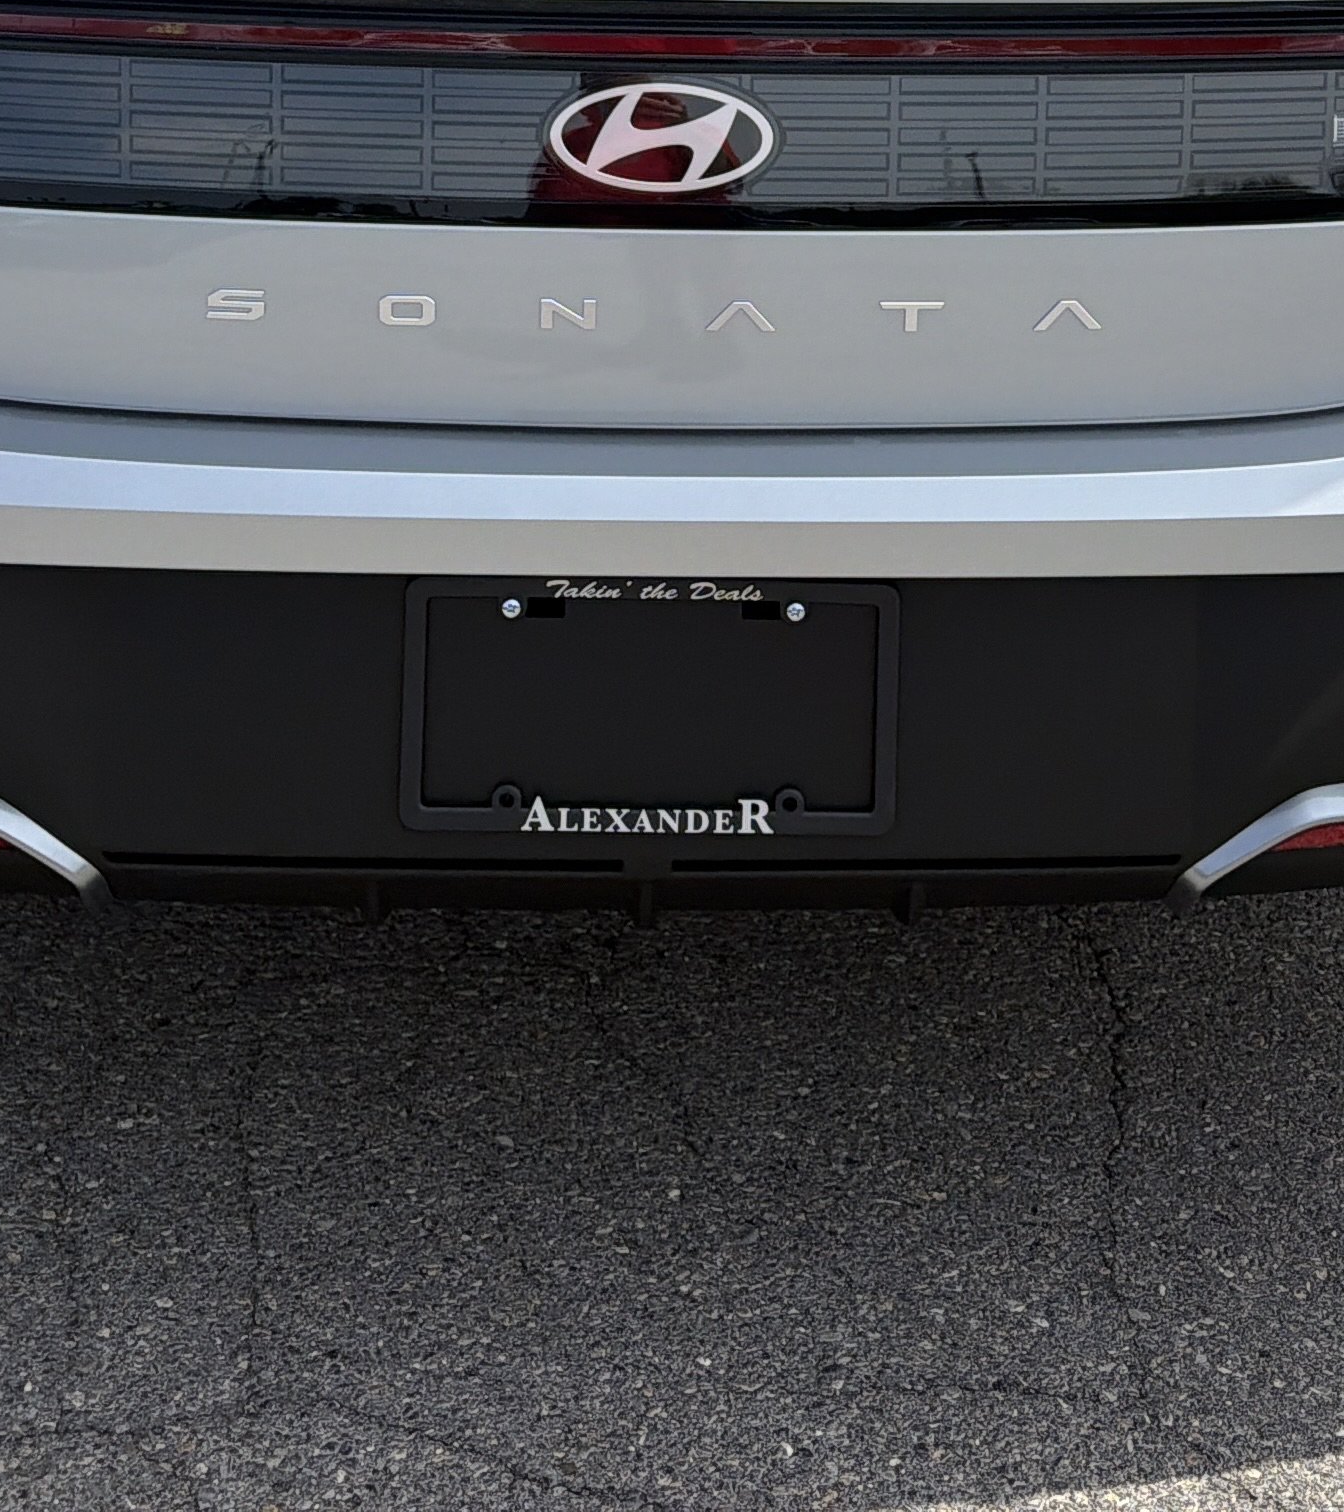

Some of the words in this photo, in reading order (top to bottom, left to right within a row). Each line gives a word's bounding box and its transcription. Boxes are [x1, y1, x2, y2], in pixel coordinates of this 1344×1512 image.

[206, 289, 1102, 332] SONATA
[639, 583, 679, 601] the
[688, 583, 765, 602] Deals
